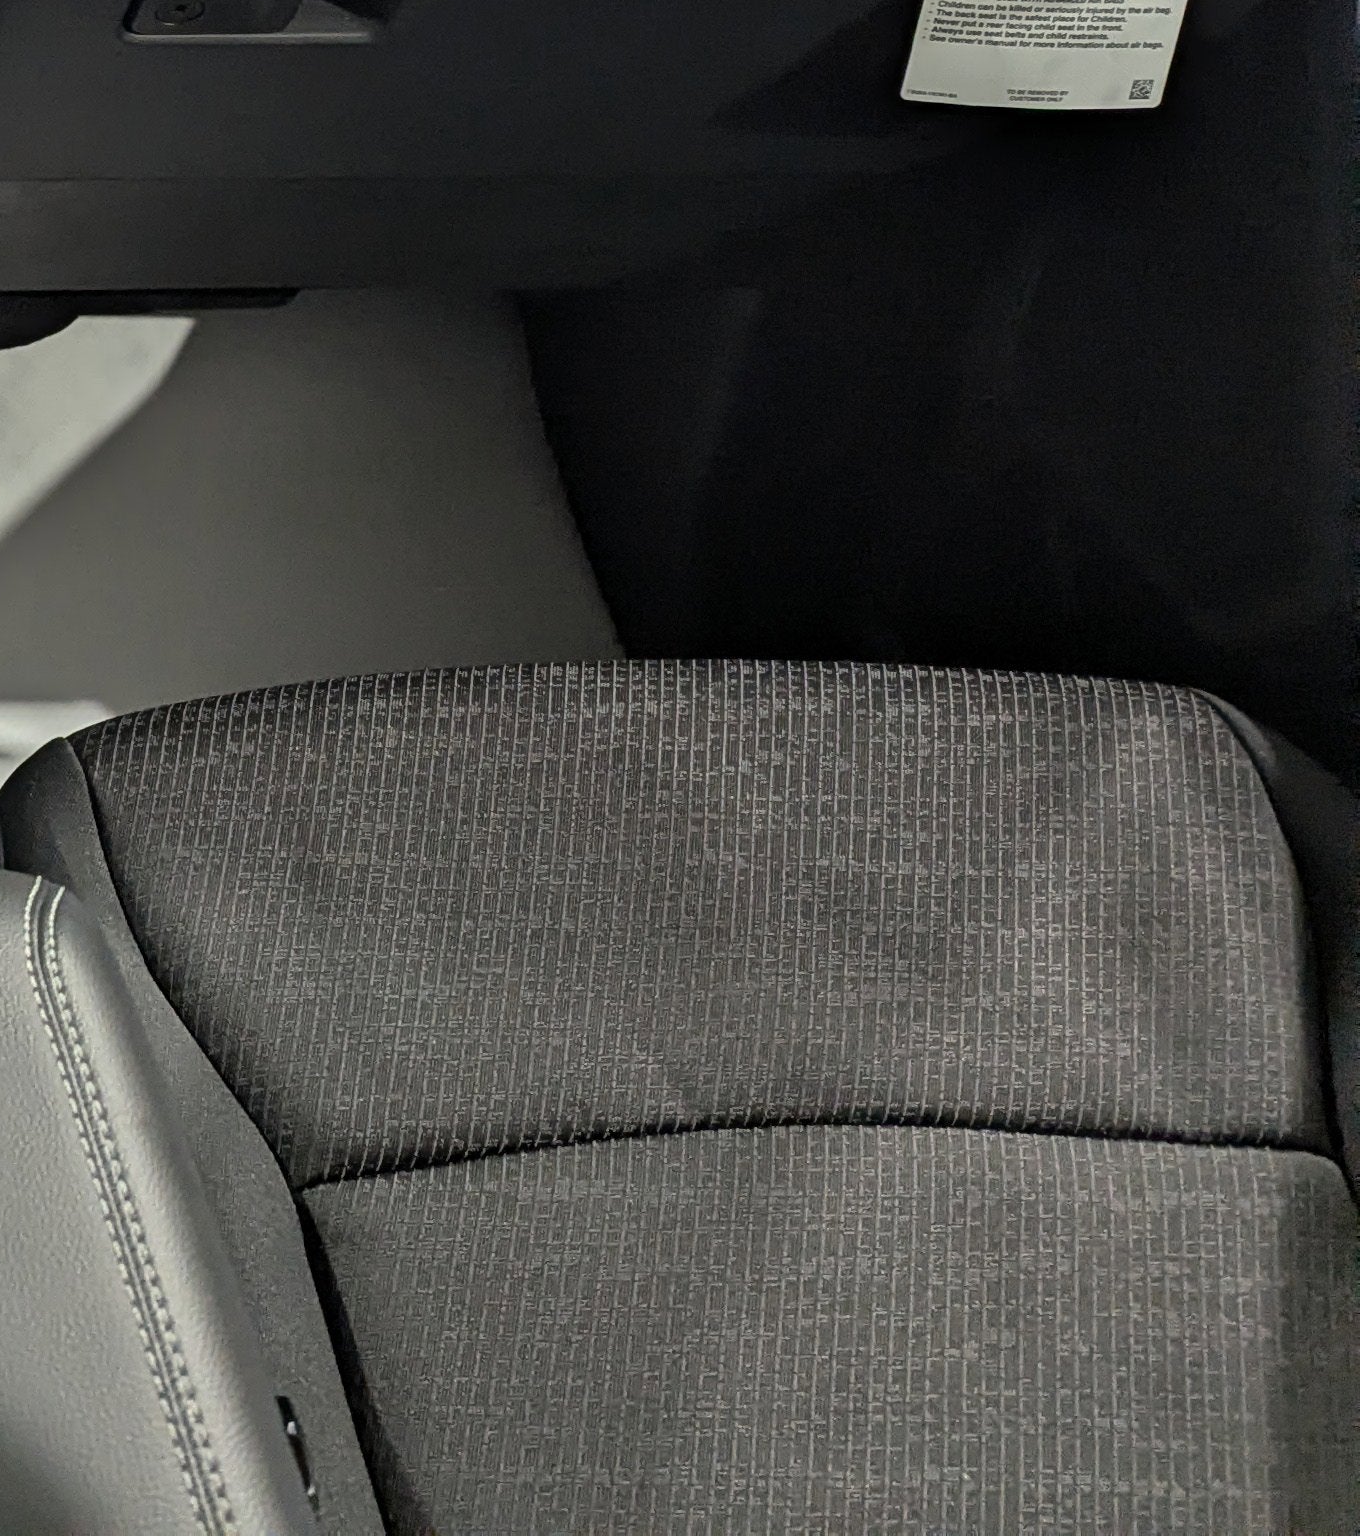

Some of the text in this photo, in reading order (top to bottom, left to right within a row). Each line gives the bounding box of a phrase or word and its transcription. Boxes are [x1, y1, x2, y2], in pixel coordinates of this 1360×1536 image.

[938, 0, 976, 10] Children
[995, 4, 1007, 12] be
[1008, 4, 1033, 13] killed
[1045, 6, 1084, 15] seriously
[1085, 7, 1115, 16] injured
[1116, 7, 1126, 16] by
[936, 9, 952, 17] The
[954, 10, 976, 19] back
[977, 12, 997, 20] seat
[1009, 13, 1023, 21] the
[1025, 13, 1051, 22] safest
[1051, 15, 1076, 24] place
[1077, 15, 1089, 23] for
[933, 18, 960, 26] Never
[961, 20, 977, 29] put
[1005, 22, 1032, 32] facing
[1034, 23, 1055, 31] child
[931, 26, 964, 36] Always
[1004, 30, 1026, 38] belts
[1027, 31, 1044, 39] and
[1045, 32, 1067, 40] child
[929, 34, 946, 42] See
[948, 36, 983, 45] owner's
[984, 38, 1017, 46] manual
[1057, 41, 1104, 49] information
[1105, 41, 1129, 49] about
